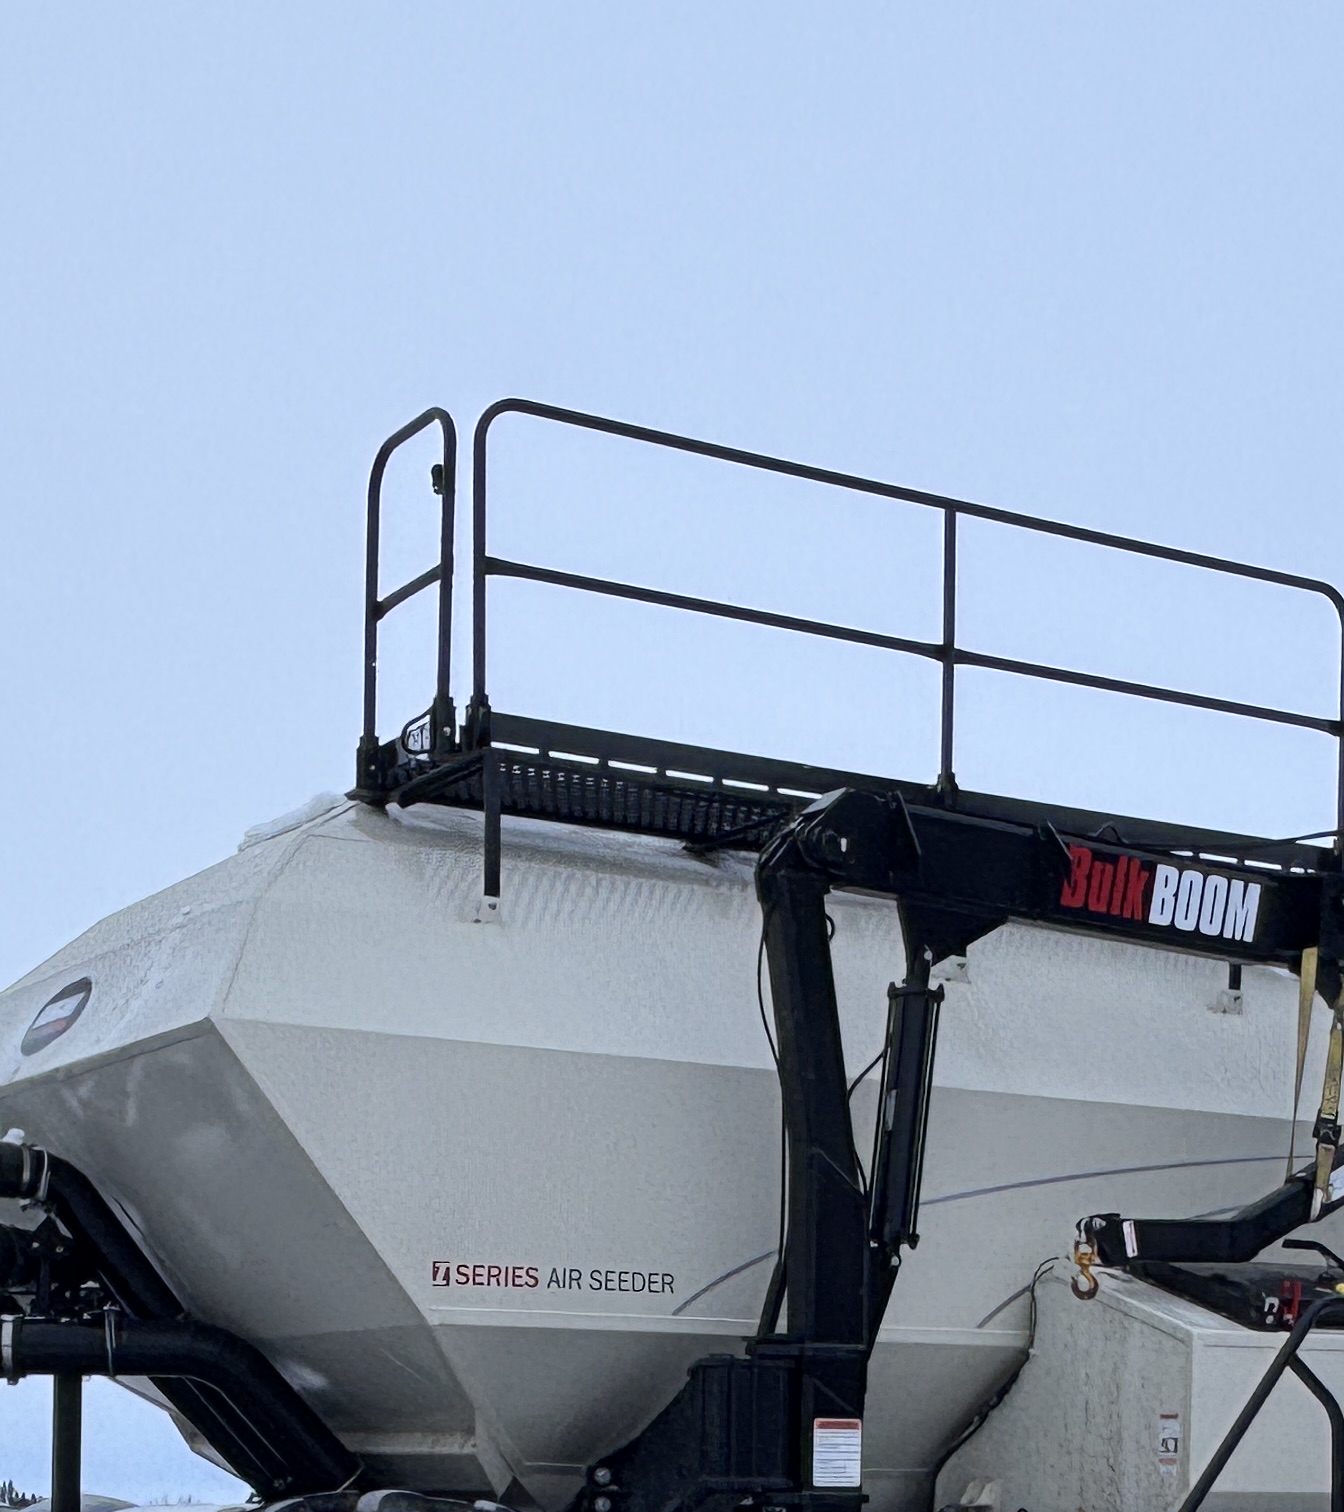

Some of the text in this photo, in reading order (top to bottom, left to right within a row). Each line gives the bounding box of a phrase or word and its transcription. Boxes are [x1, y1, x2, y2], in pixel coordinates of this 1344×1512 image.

[455, 1263, 540, 1289] SERIES
[547, 1267, 583, 1291] AIR
[588, 1268, 675, 1295] SEEDER
